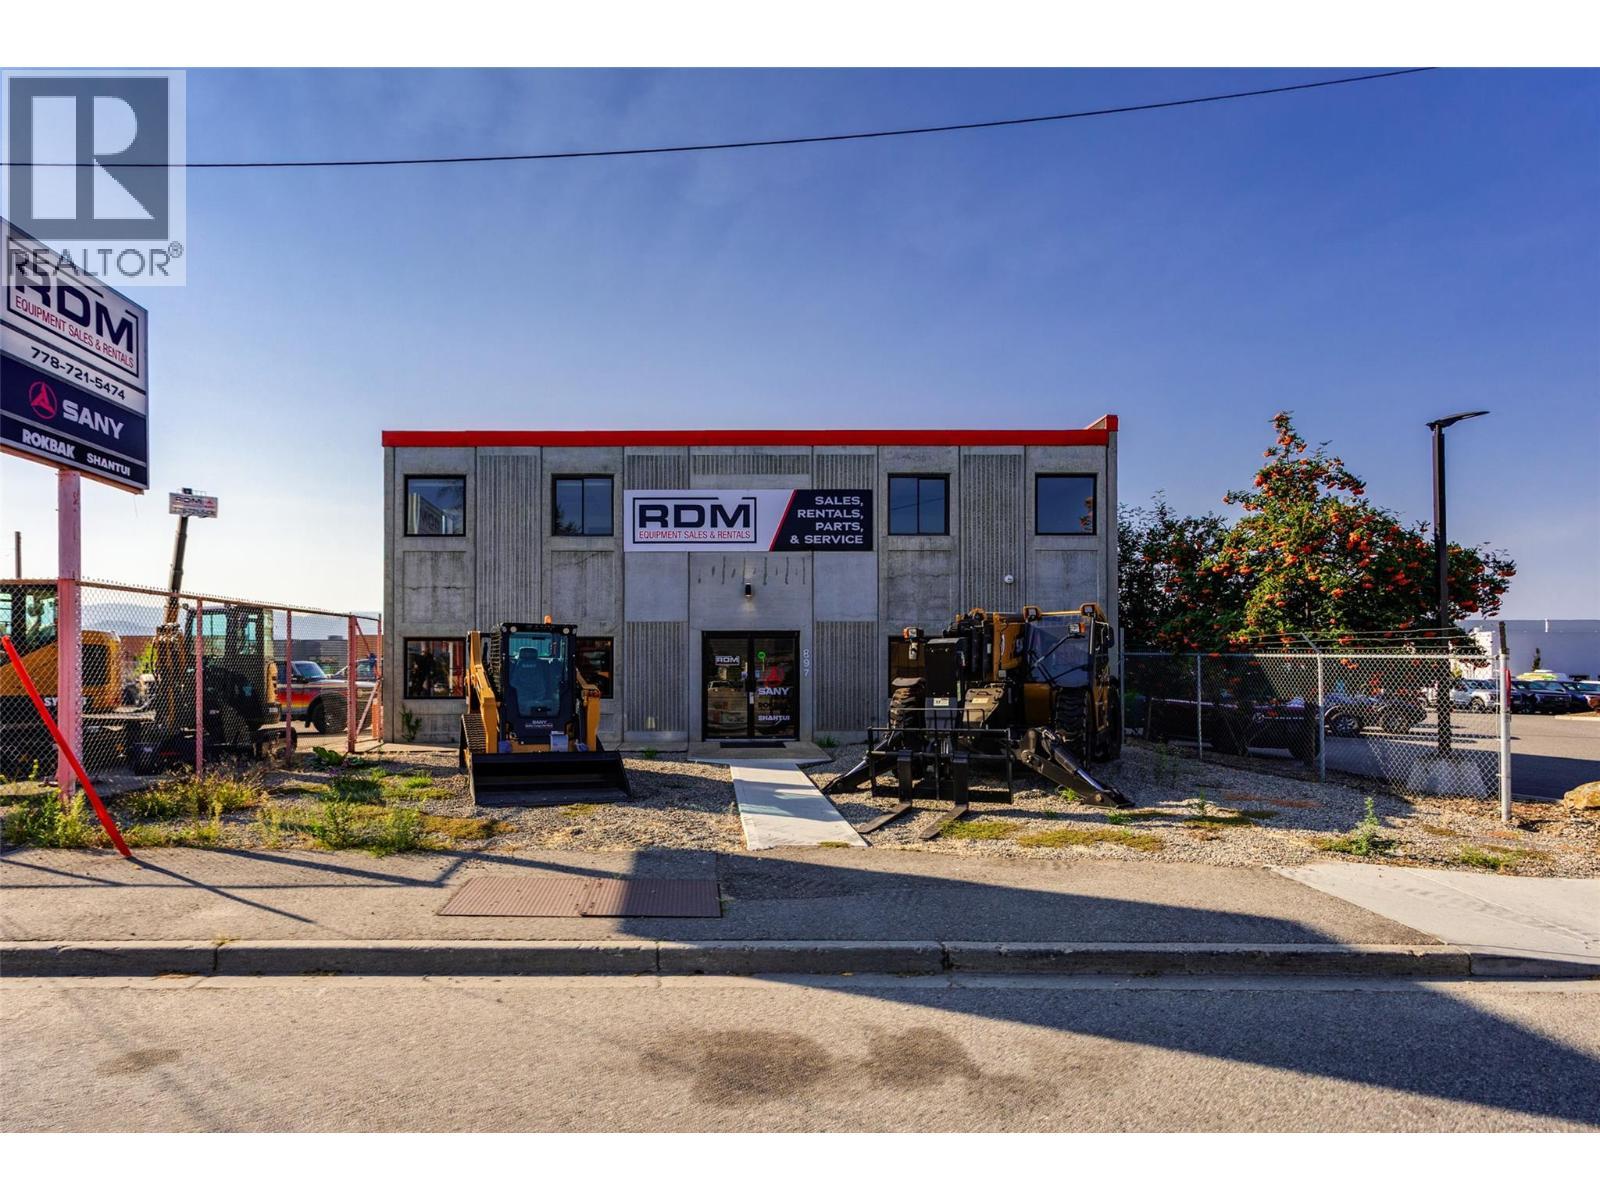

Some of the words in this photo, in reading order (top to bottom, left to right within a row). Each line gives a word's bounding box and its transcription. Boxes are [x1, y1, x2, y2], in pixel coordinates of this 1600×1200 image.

[15, 253, 134, 354] RDM
[15, 295, 67, 333] EQUIPMENT
[68, 323, 94, 347] SALES
[95, 338, 102, 351] &
[102, 341, 135, 369] RENTALS
[31, 346, 126, 401] 778-721-5474
[62, 399, 124, 440] SANY
[22, 428, 76, 459] ROKBAK
[86, 452, 131, 476] SHANTUI
[814, 495, 865, 507] SALES,
[638, 503, 751, 529] RDM
[797, 509, 865, 520] RENTALS,
[639, 530, 681, 539] EQUIPMENT
[684, 530, 708, 539] SALES
[709, 530, 716, 539] &
[717, 530, 751, 539] RENTALS
[815, 522, 865, 533] PARTS,
[790, 534, 800, 545] &
[804, 534, 864, 545] SERVICE
[758, 687, 790, 696] SANY
